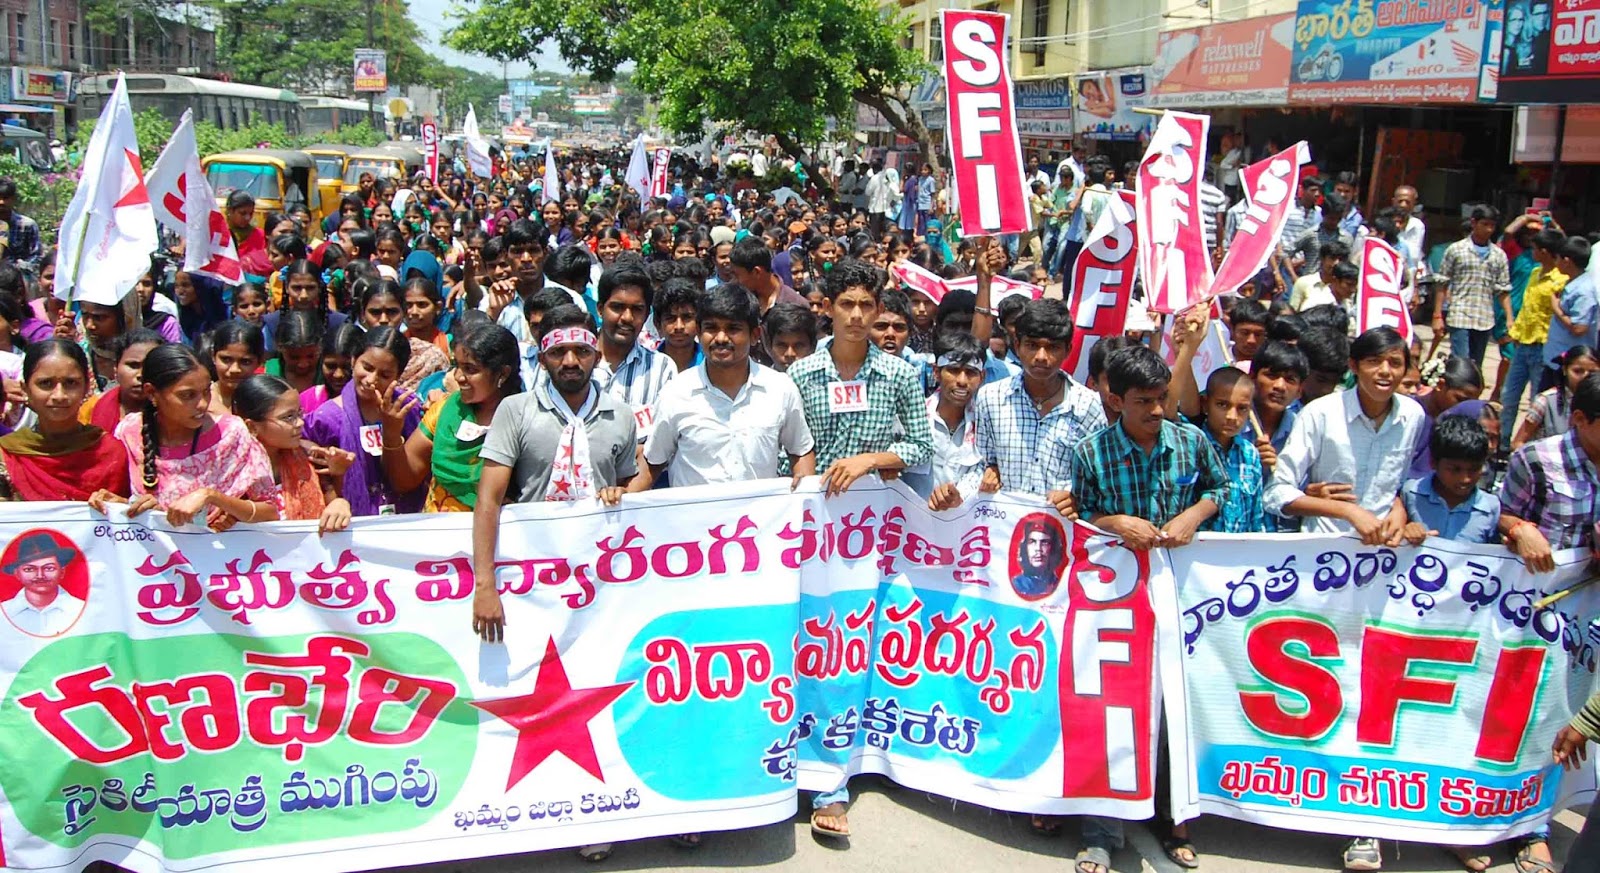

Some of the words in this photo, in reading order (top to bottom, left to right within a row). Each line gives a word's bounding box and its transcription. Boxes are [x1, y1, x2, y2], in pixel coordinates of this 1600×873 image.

[1017, 79, 1064, 96] COSMOS
[1406, 64, 1444, 76] Hero
[951, 19, 1002, 231] SFI
[424, 124, 436, 179] SFI
[654, 149, 669, 197] SFI
[553, 328, 589, 345] SFI
[634, 406, 654, 429] FI
[834, 385, 862, 405] SFI
[134, 547, 397, 626] ప్రభుత్వ
[1073, 535, 1140, 793] SFI
[1237, 612, 1549, 766] SFI
[279, 757, 439, 815] ముగింపు
[1220, 756, 1327, 807] ఖమ్మం
[1339, 767, 1428, 811] నగర
[453, 803, 522, 831] ఖమ్మం
